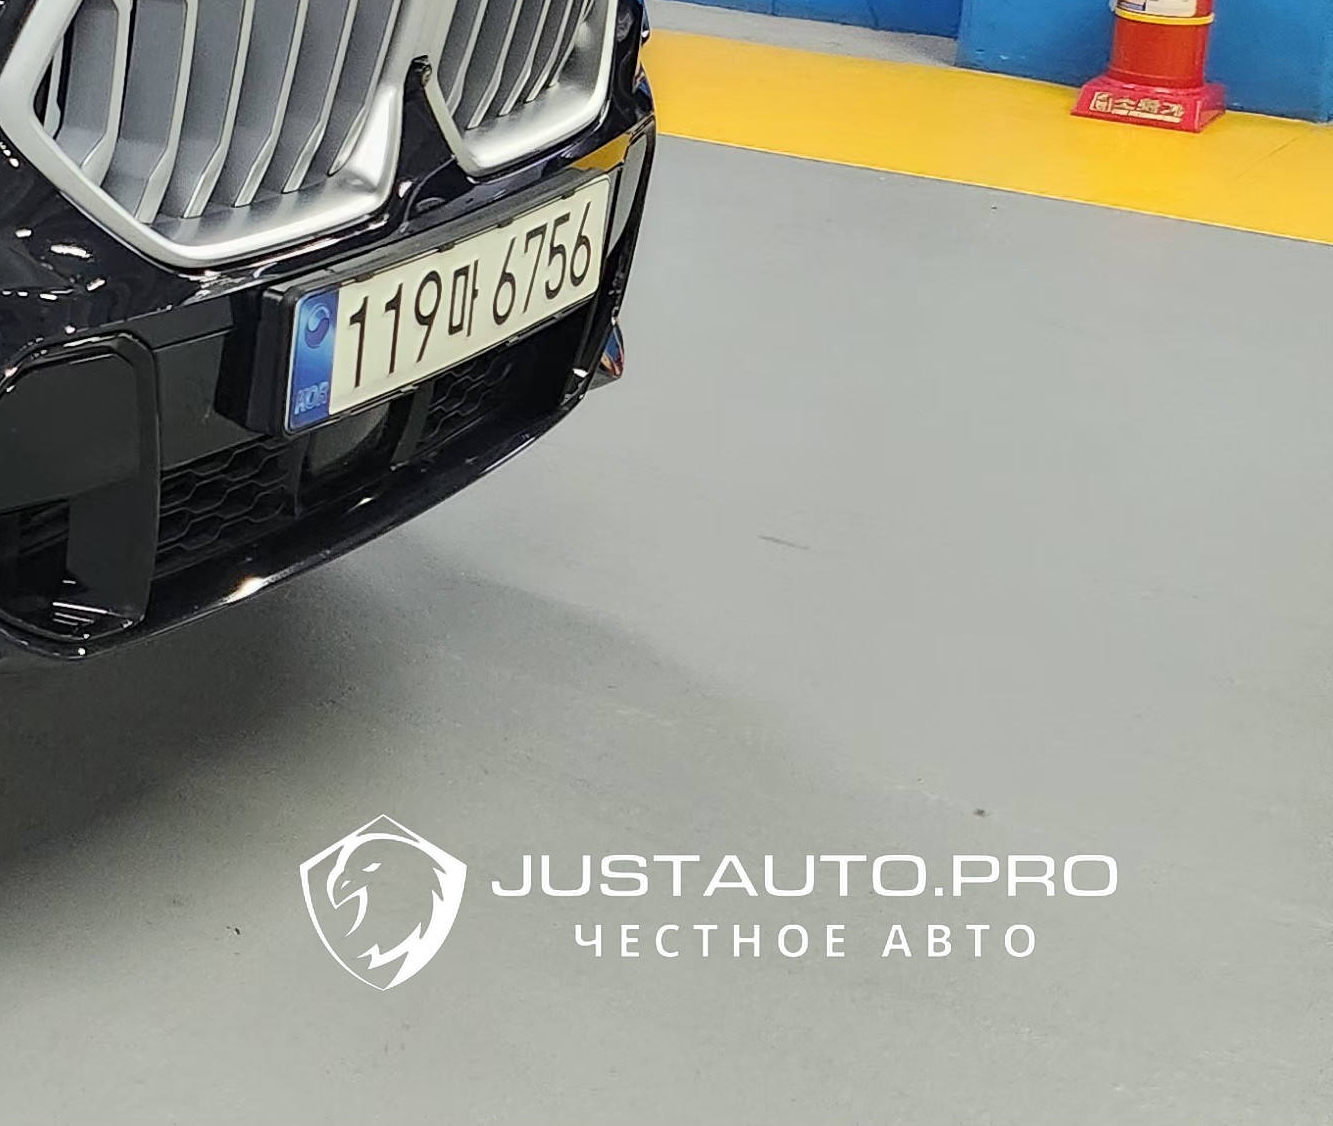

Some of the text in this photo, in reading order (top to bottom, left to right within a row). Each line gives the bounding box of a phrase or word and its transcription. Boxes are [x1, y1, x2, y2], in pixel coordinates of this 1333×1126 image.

[349, 200, 592, 389] 119마 6756
[294, 381, 329, 415] KOR
